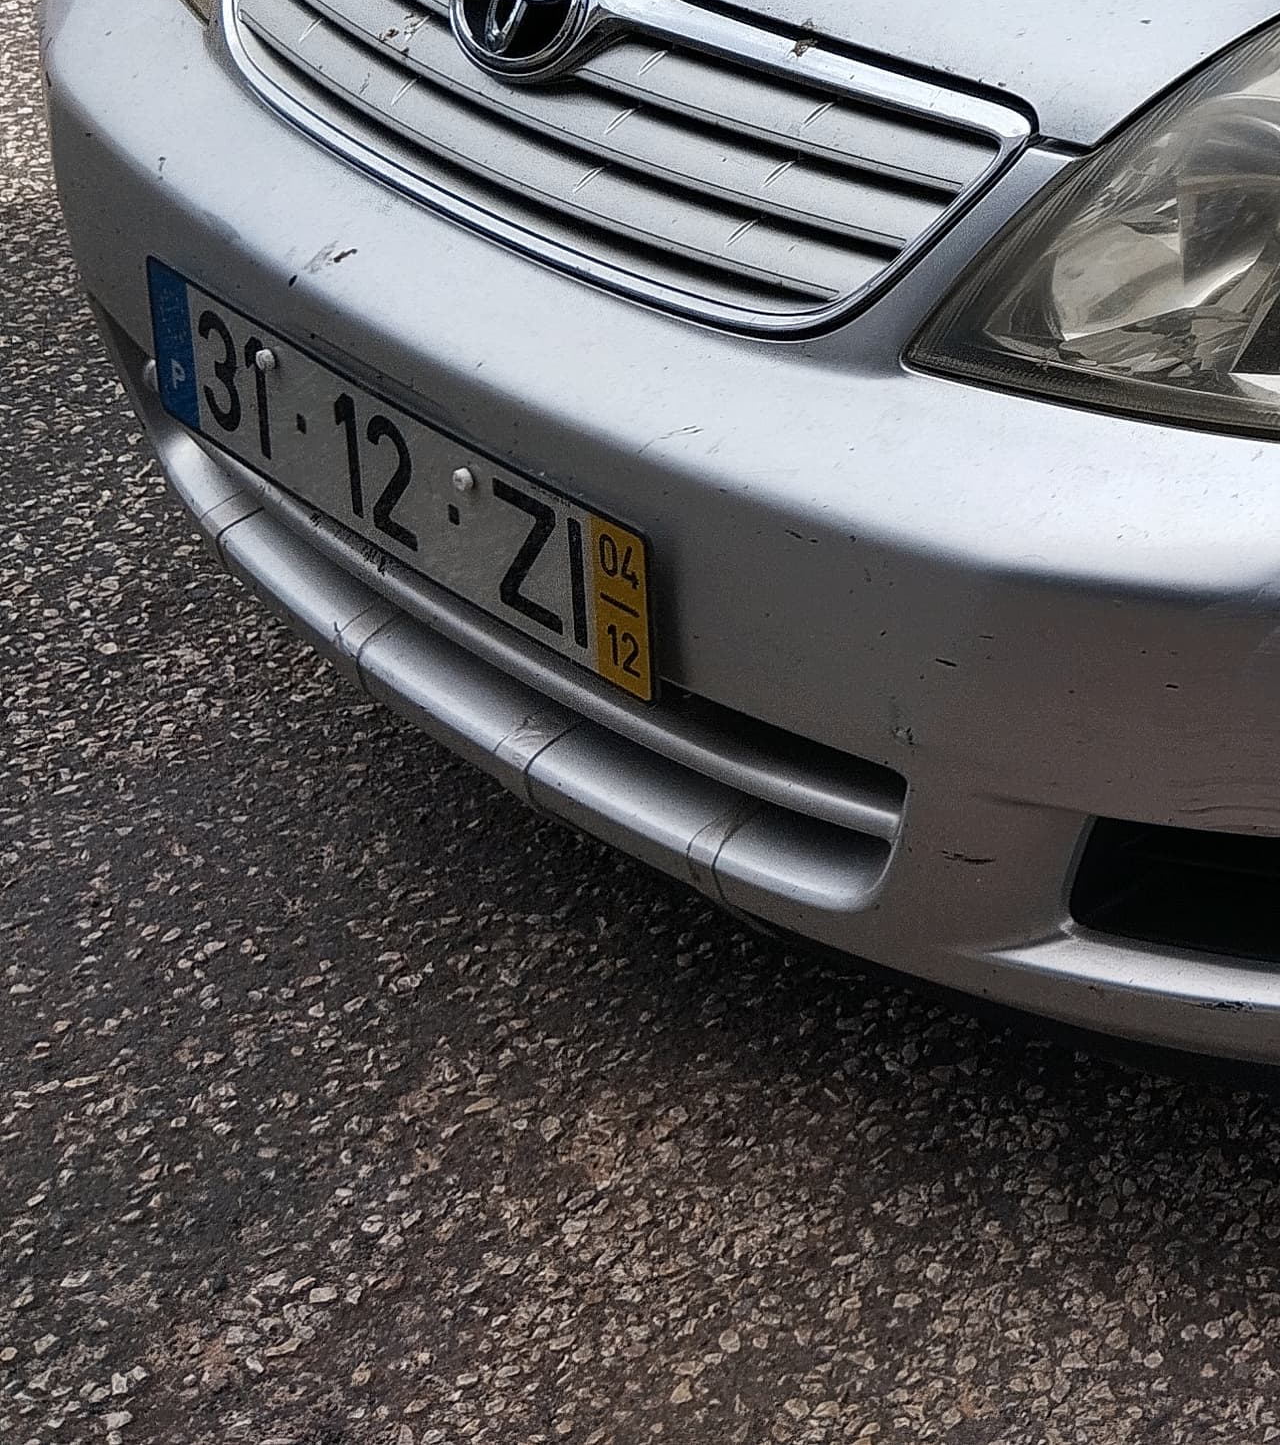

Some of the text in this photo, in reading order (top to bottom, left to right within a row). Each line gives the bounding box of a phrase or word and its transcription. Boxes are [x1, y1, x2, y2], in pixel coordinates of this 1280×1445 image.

[170, 358, 187, 391] P
[599, 533, 640, 591] 04
[607, 623, 641, 679] 12
